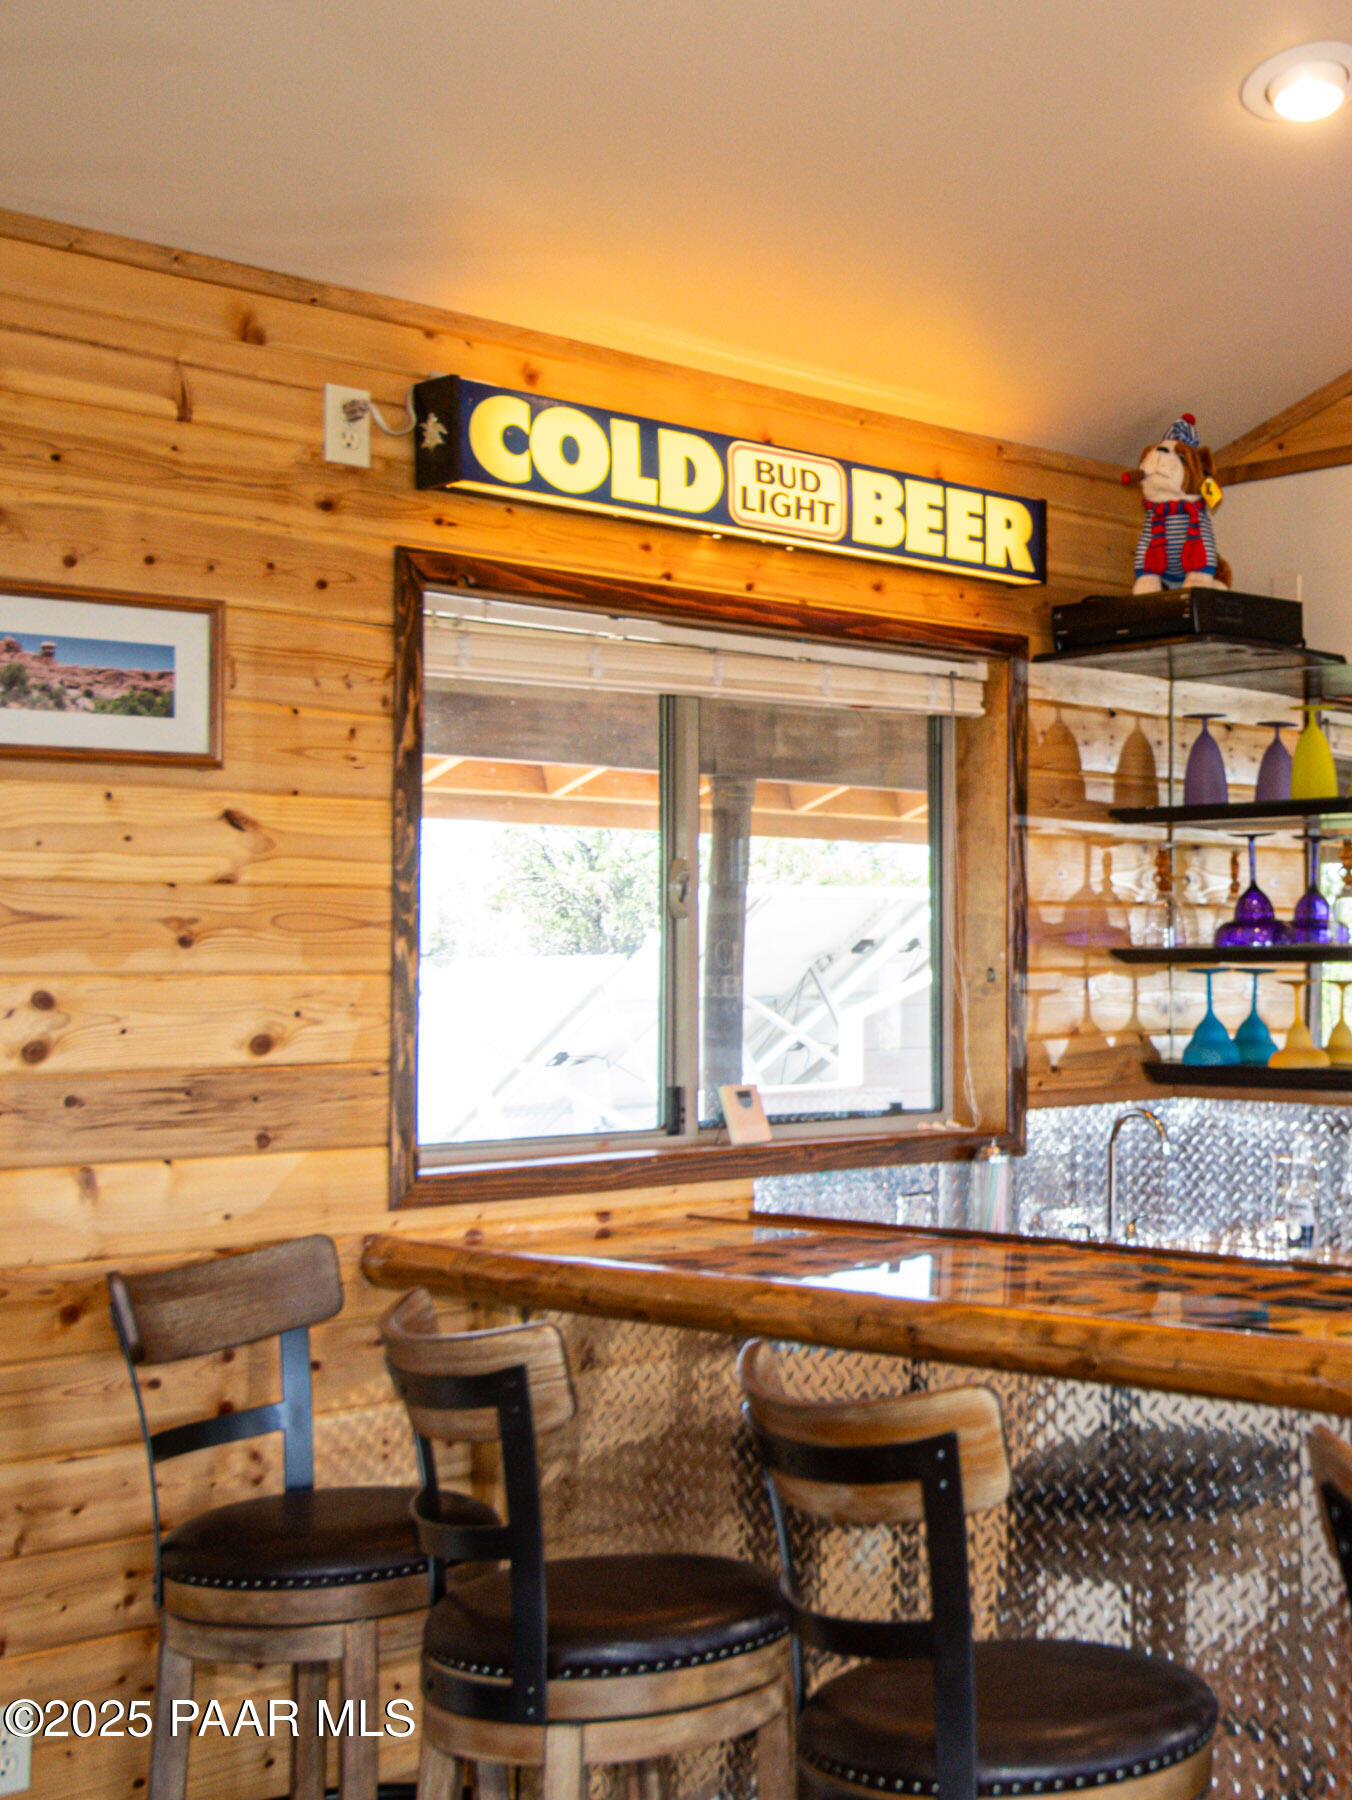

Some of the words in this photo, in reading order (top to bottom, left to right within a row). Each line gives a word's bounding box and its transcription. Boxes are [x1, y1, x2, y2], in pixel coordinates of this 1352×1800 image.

[468, 394, 725, 514] COLD
[850, 467, 1036, 573] BEER
[754, 459, 821, 495] BUD
[740, 489, 836, 527] LIGHT
